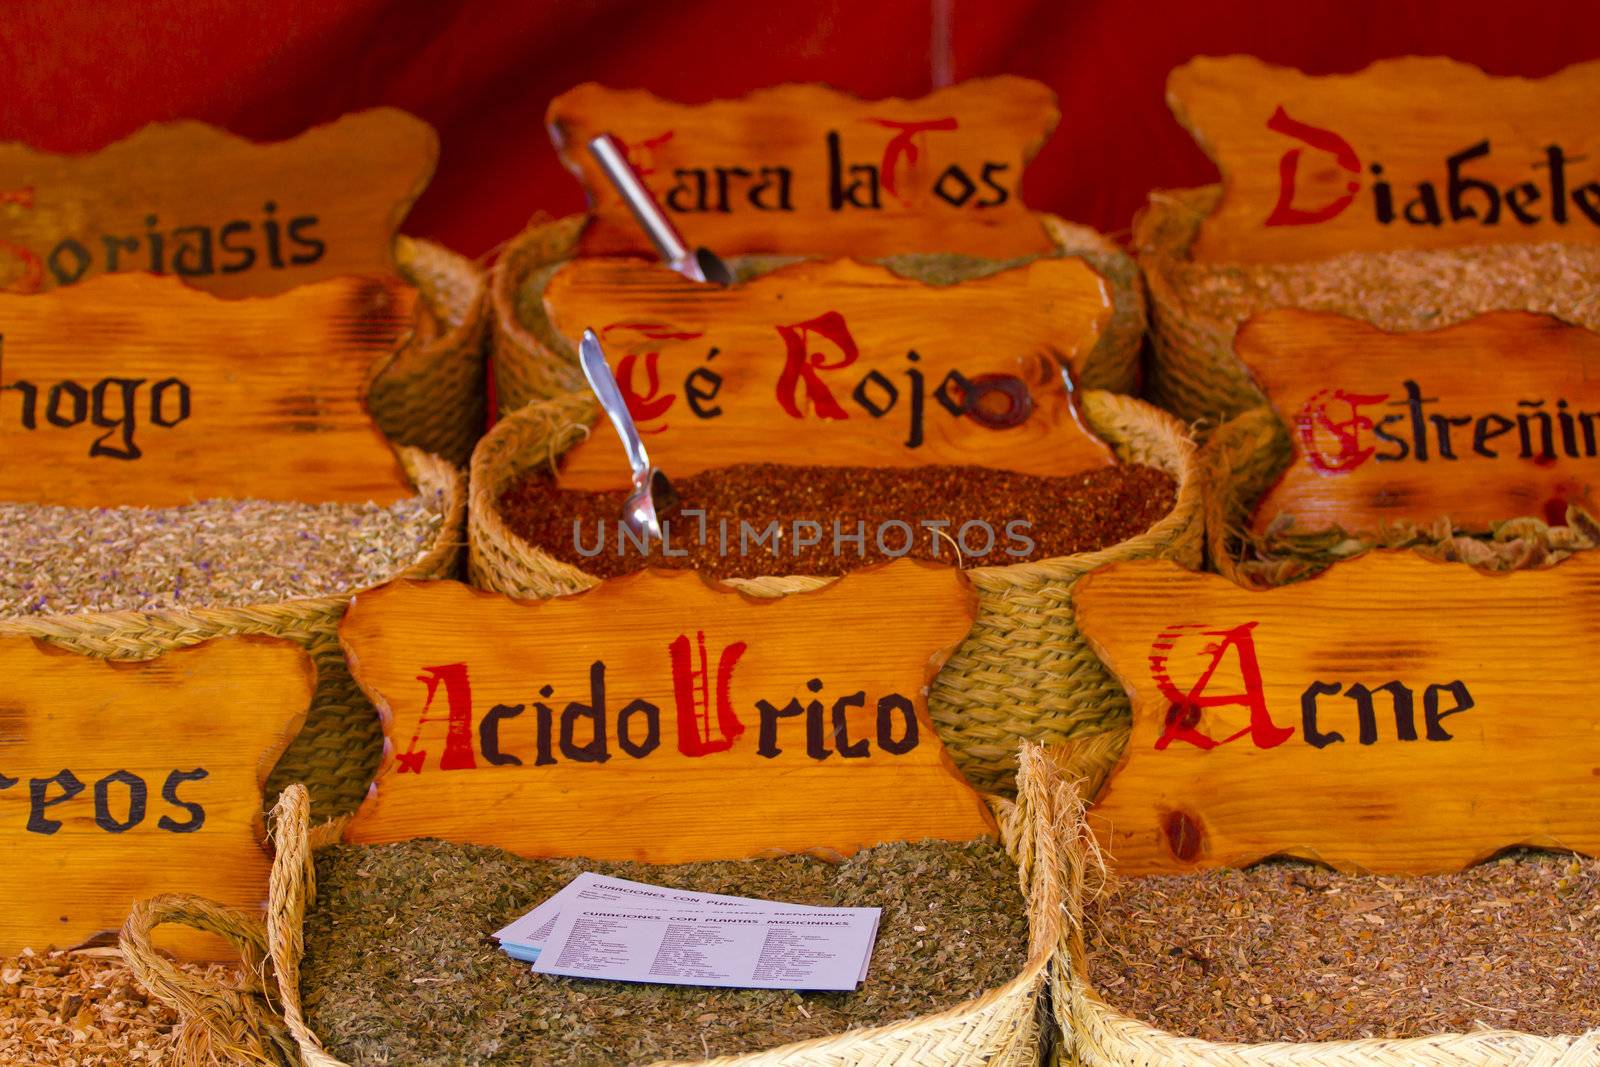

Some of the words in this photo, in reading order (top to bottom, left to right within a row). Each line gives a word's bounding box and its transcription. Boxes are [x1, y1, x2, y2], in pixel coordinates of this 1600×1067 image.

[600, 322, 724, 435] Té
[775, 311, 982, 448] Rojo
[396, 659, 661, 774] Acido
[668, 630, 919, 759] Urico
[1148, 621, 1475, 750] Acne
[582, 911, 662, 921] CURACIONES
[592, 883, 666, 899] CURACIONES
[672, 895, 700, 904] CON
